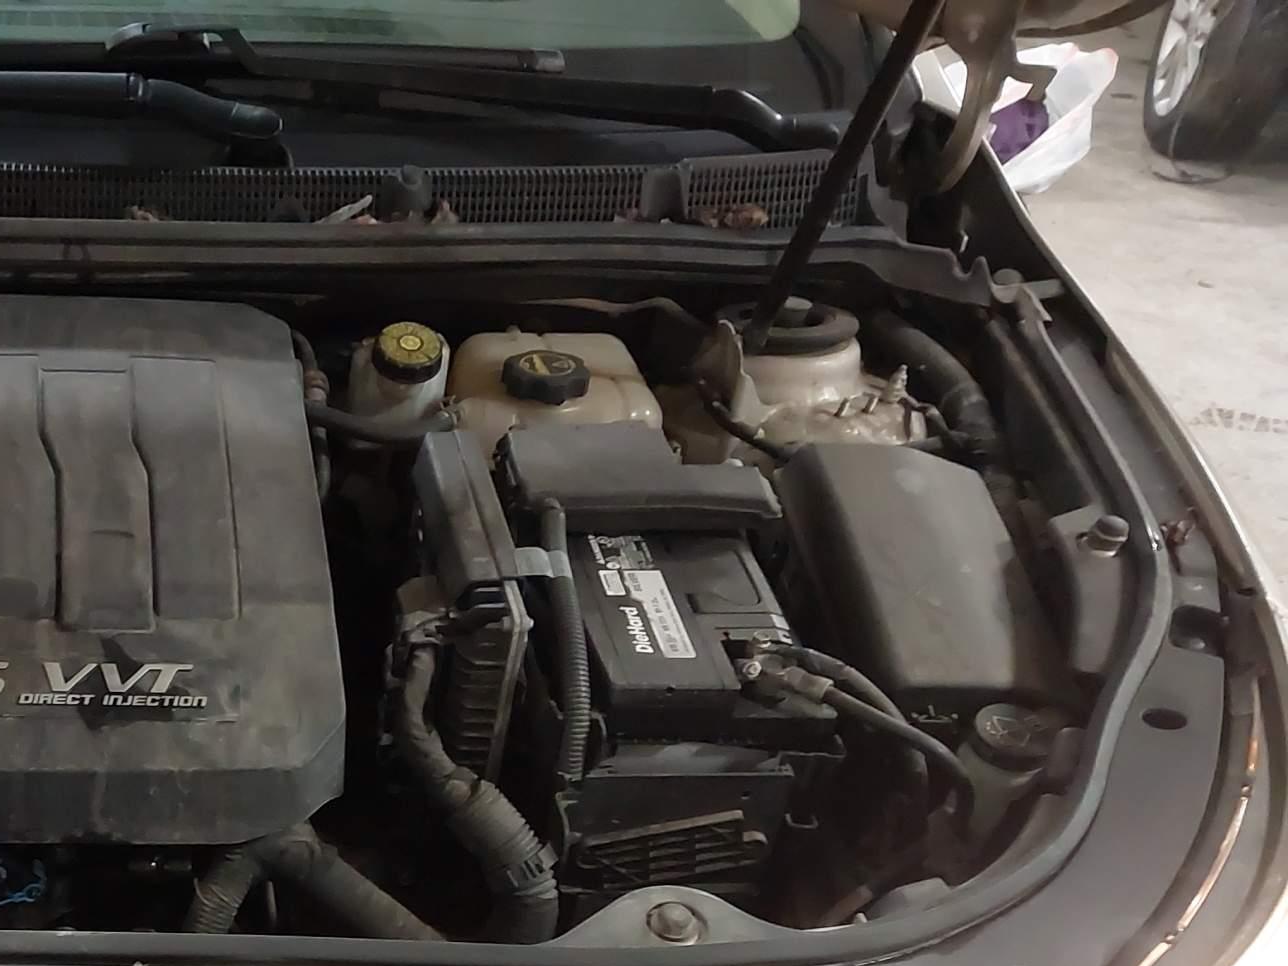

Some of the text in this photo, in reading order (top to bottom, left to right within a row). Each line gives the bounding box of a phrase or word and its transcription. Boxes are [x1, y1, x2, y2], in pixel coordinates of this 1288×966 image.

[619, 606, 654, 653] DieHard
[42, 662, 194, 692] VVT
[18, 692, 208, 708] DIRECT INJECTION
